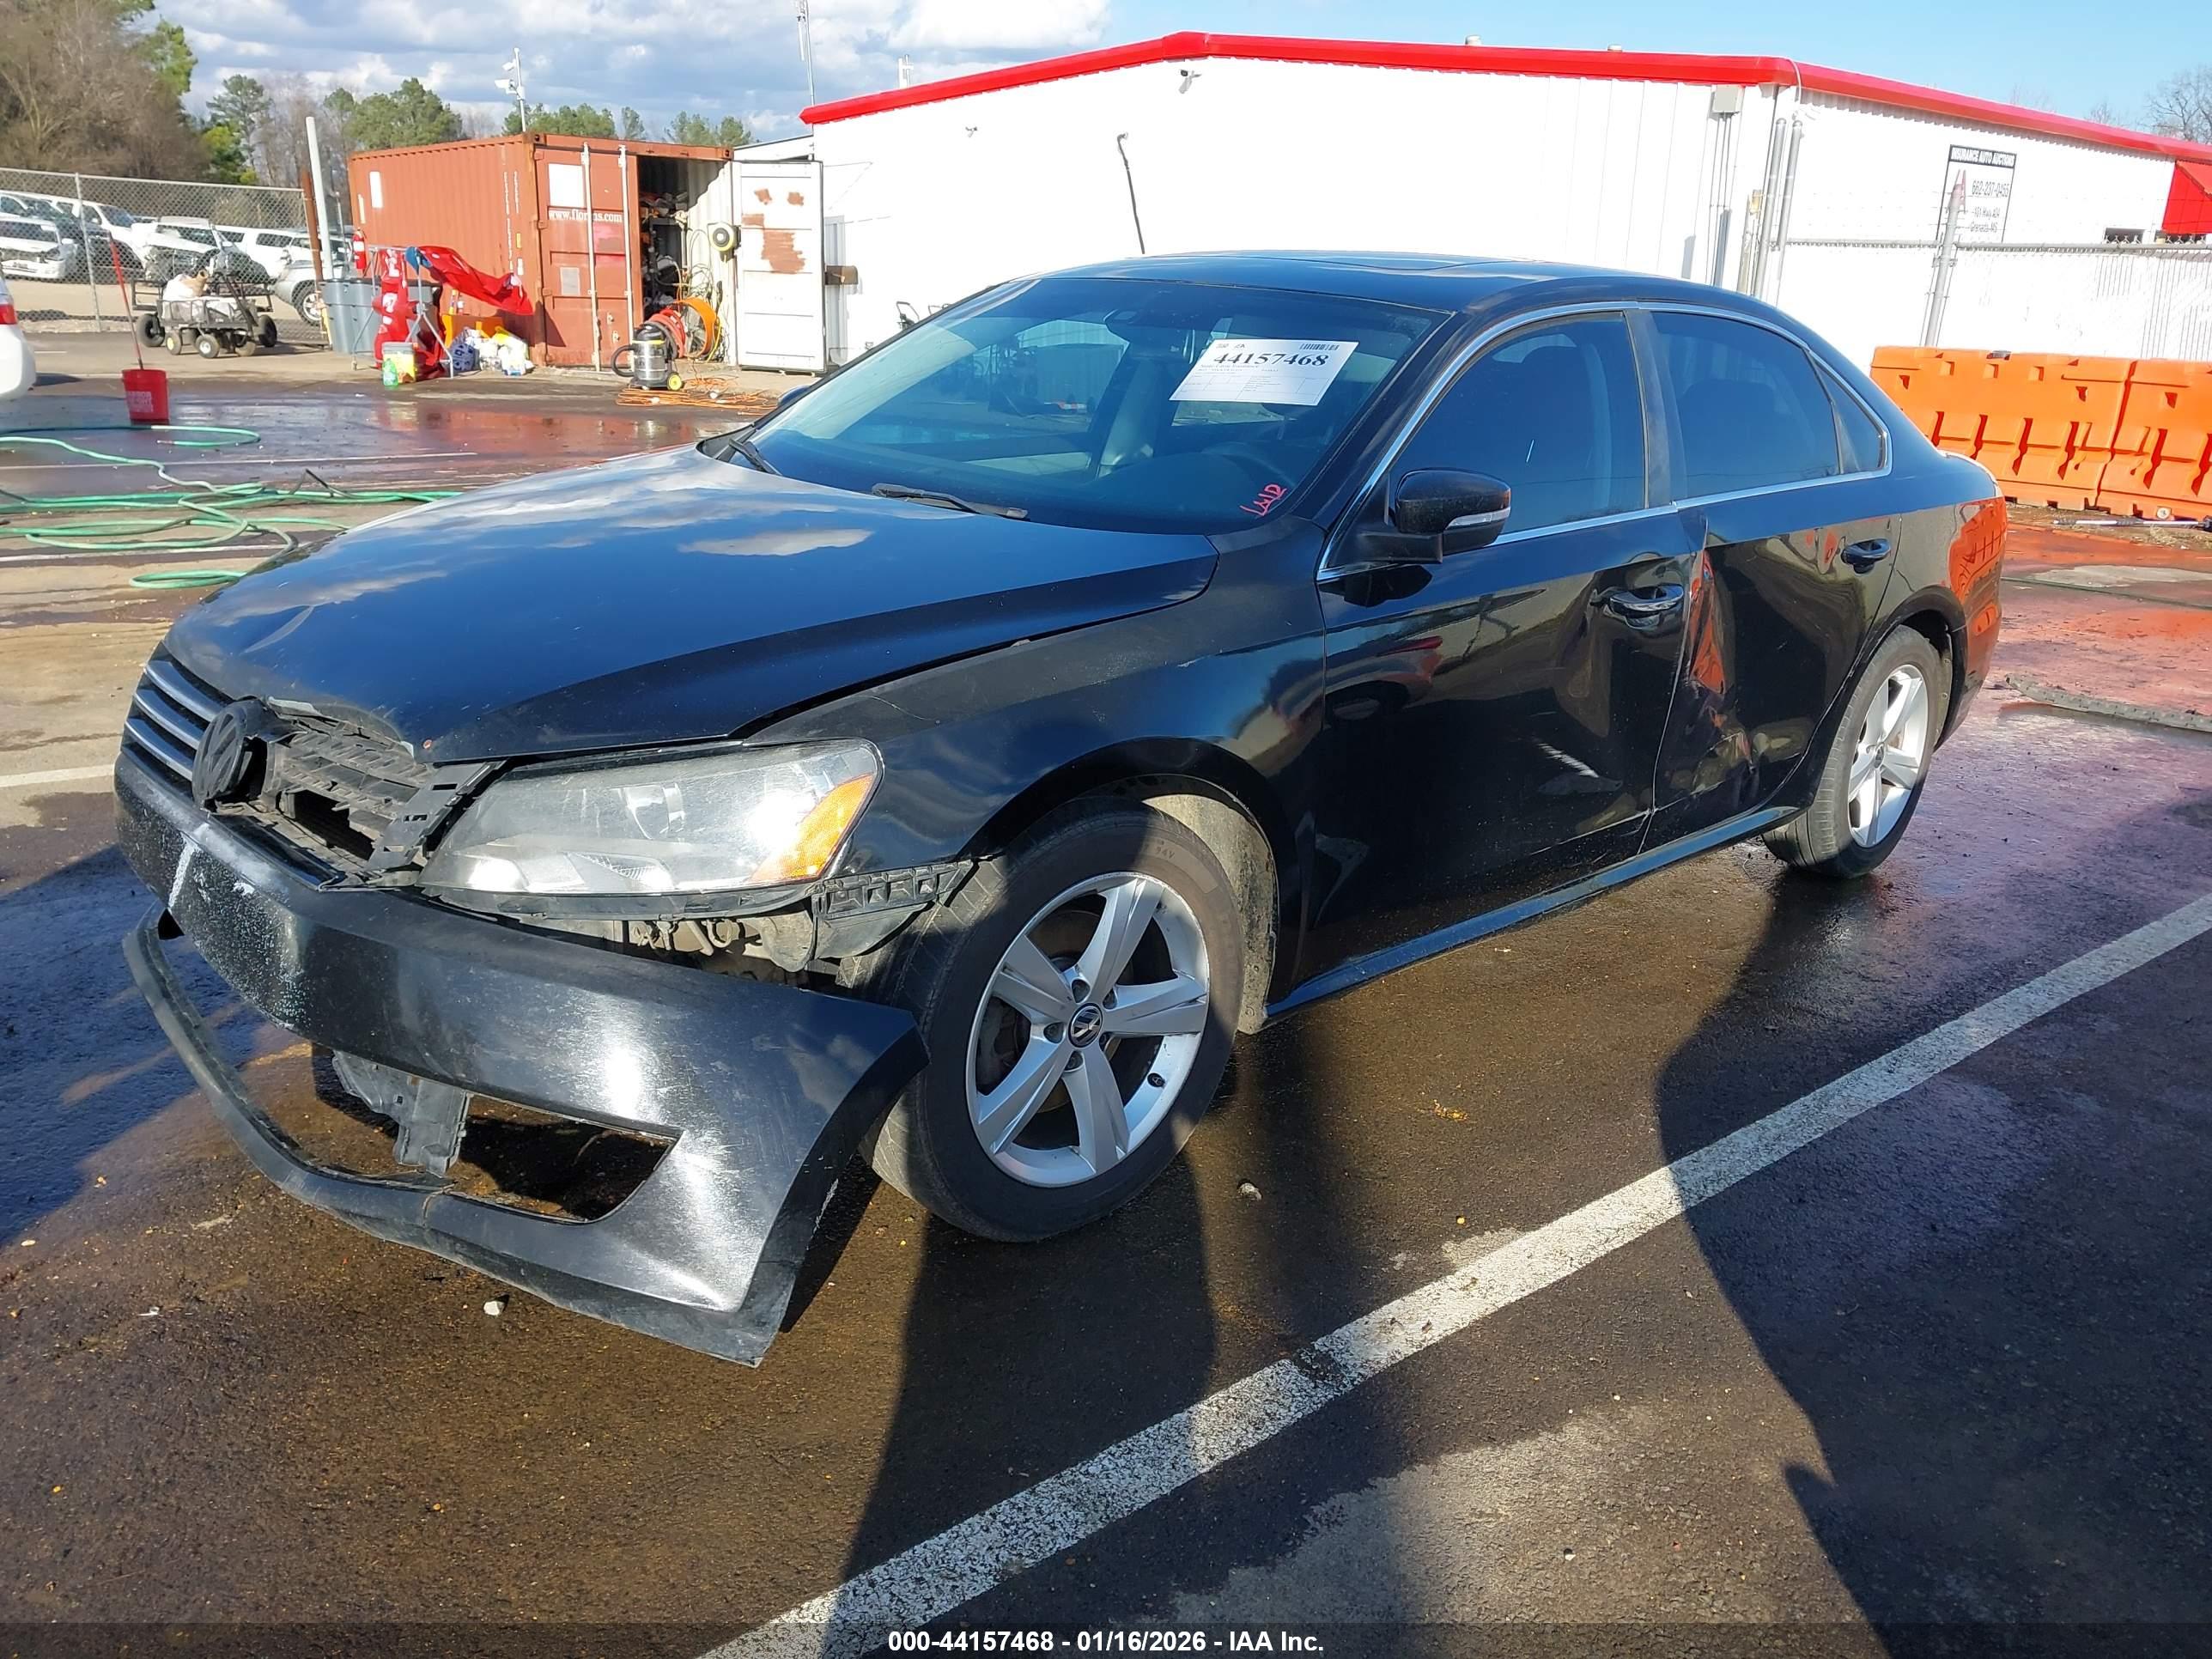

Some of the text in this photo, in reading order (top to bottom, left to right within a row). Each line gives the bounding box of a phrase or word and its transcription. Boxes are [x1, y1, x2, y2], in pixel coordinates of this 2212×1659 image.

[1951, 147, 2015, 167] INSURANCE AUTO AUCTIONS
[1214, 353, 1329, 367] 44157468
